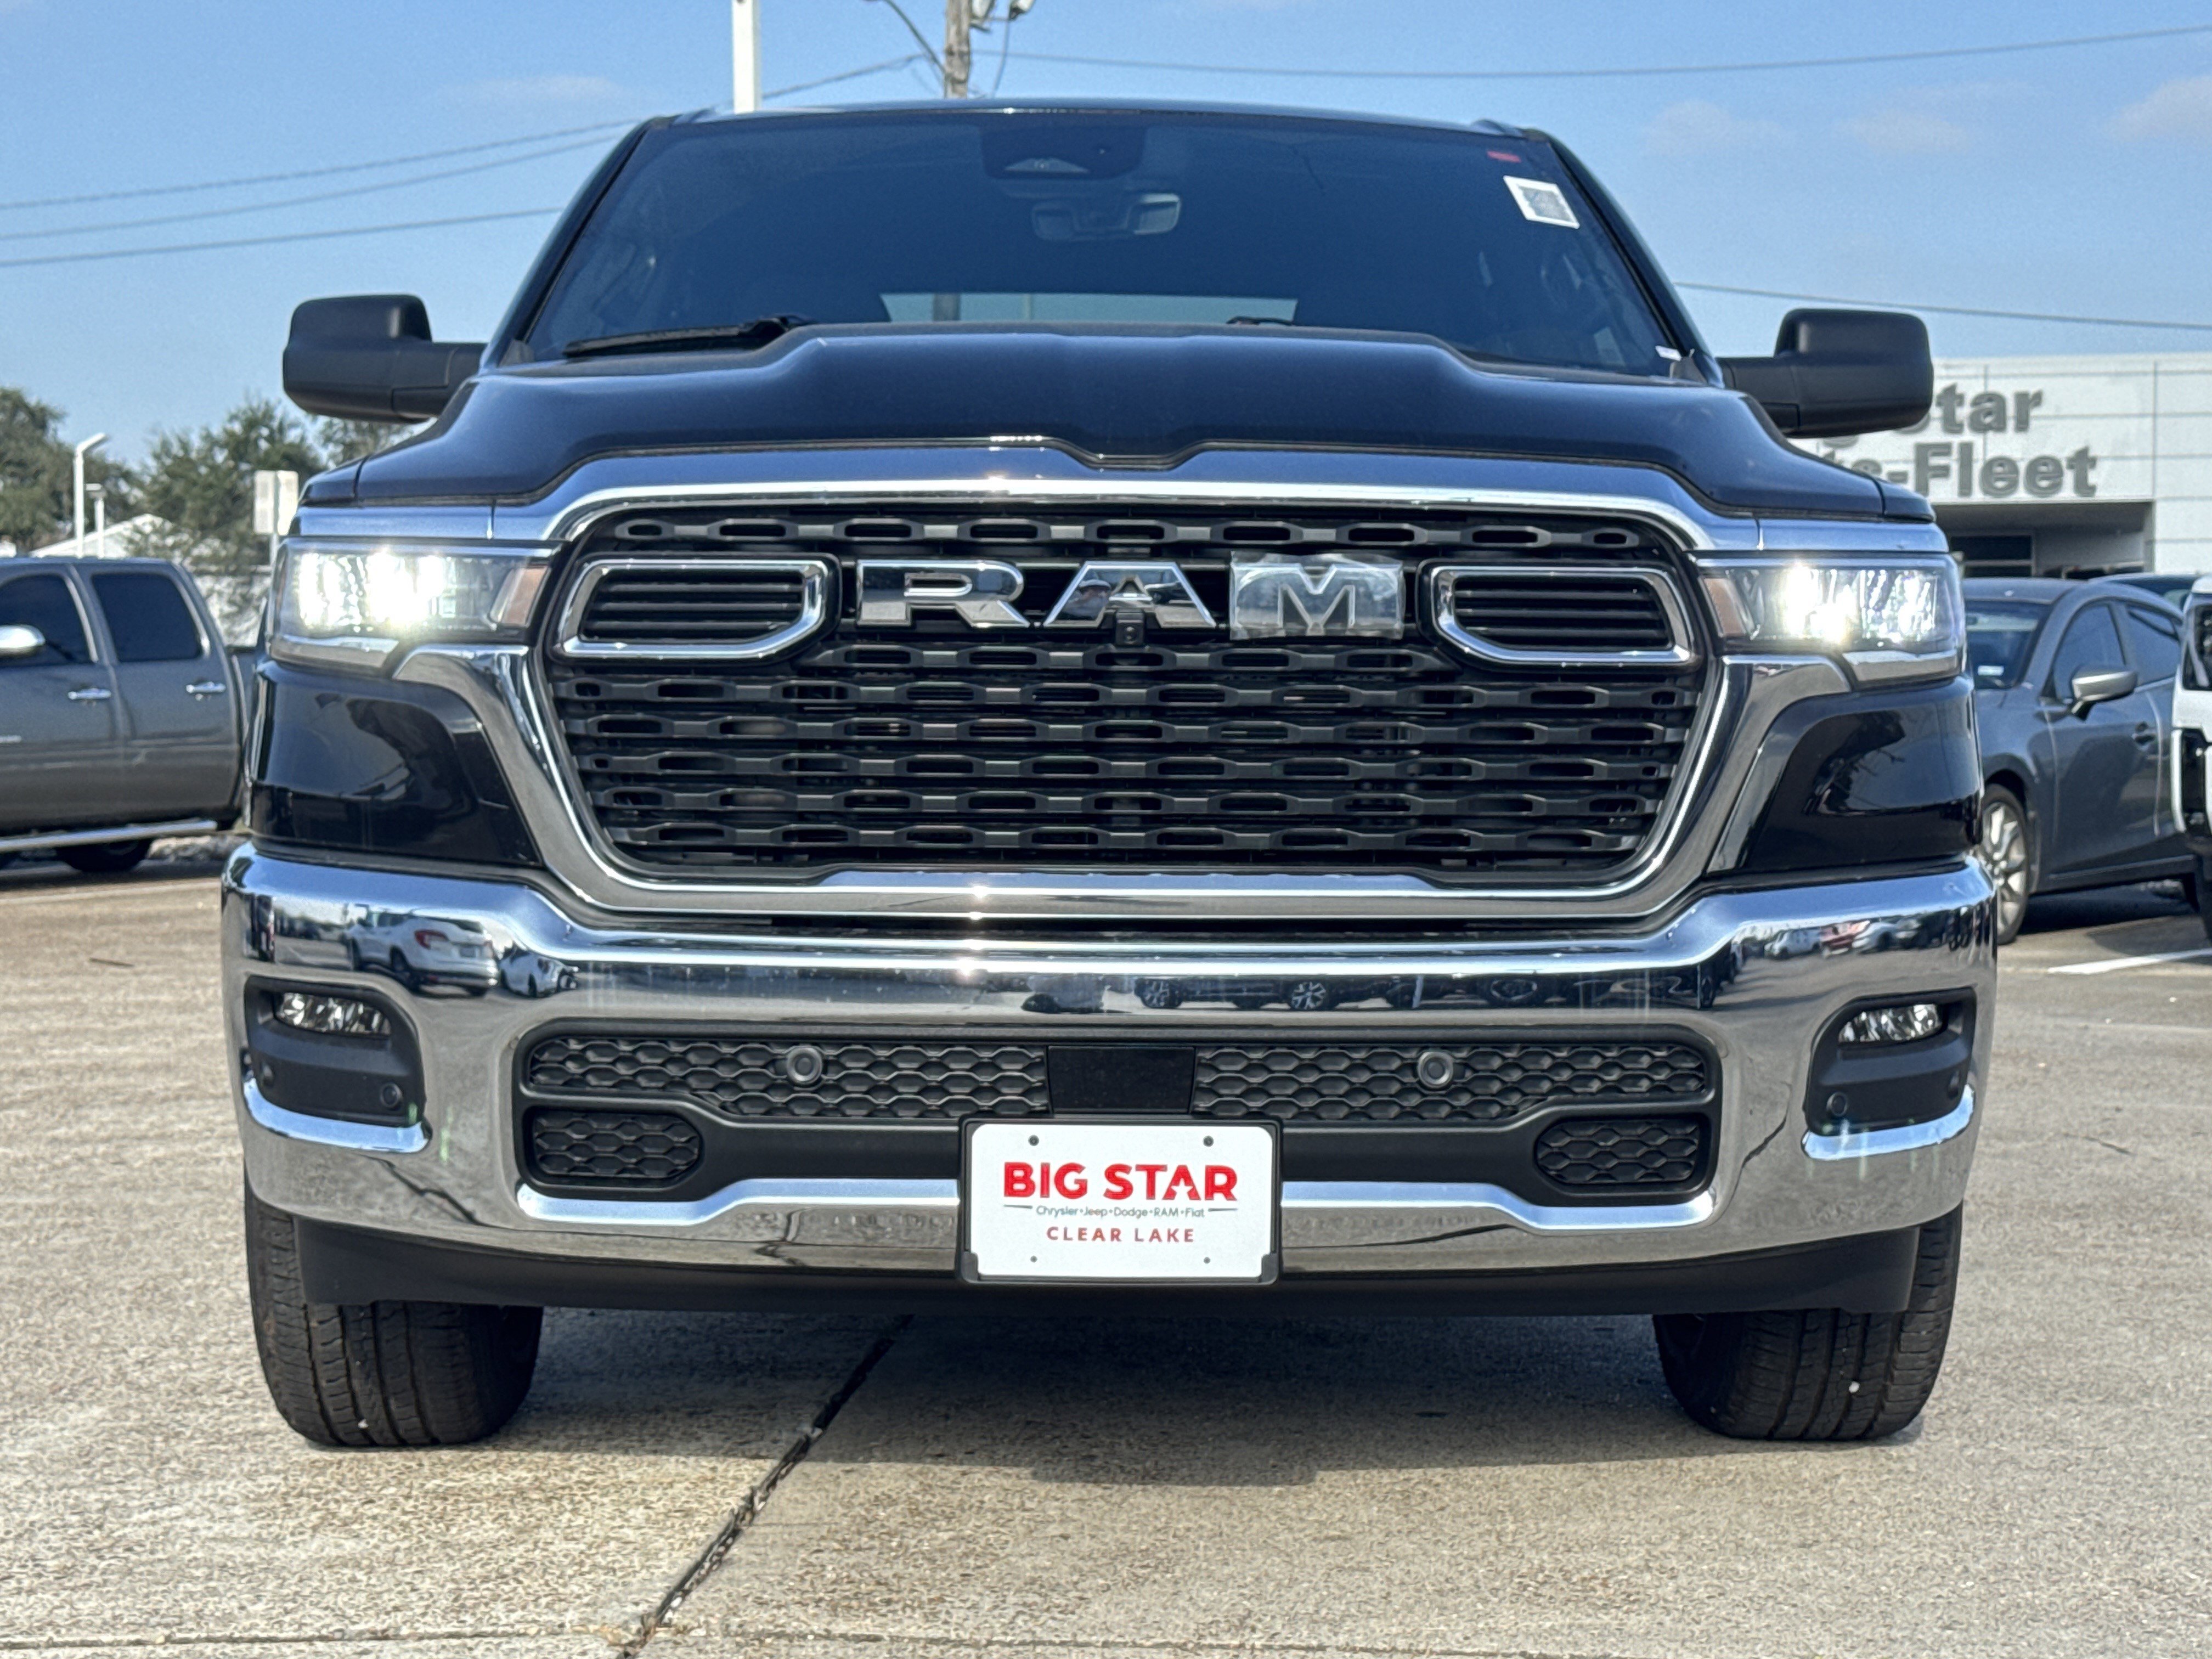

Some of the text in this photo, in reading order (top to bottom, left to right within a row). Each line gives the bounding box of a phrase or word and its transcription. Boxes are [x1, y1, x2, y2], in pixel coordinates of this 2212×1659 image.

[1895, 383, 2042, 433] tar
[1822, 441, 2098, 497] -Fleet
[857, 560, 1403, 628] RAM
[1004, 1162, 1238, 1201] BIG STAR
[1046, 1226, 1194, 1243] CLEAR LAKE
